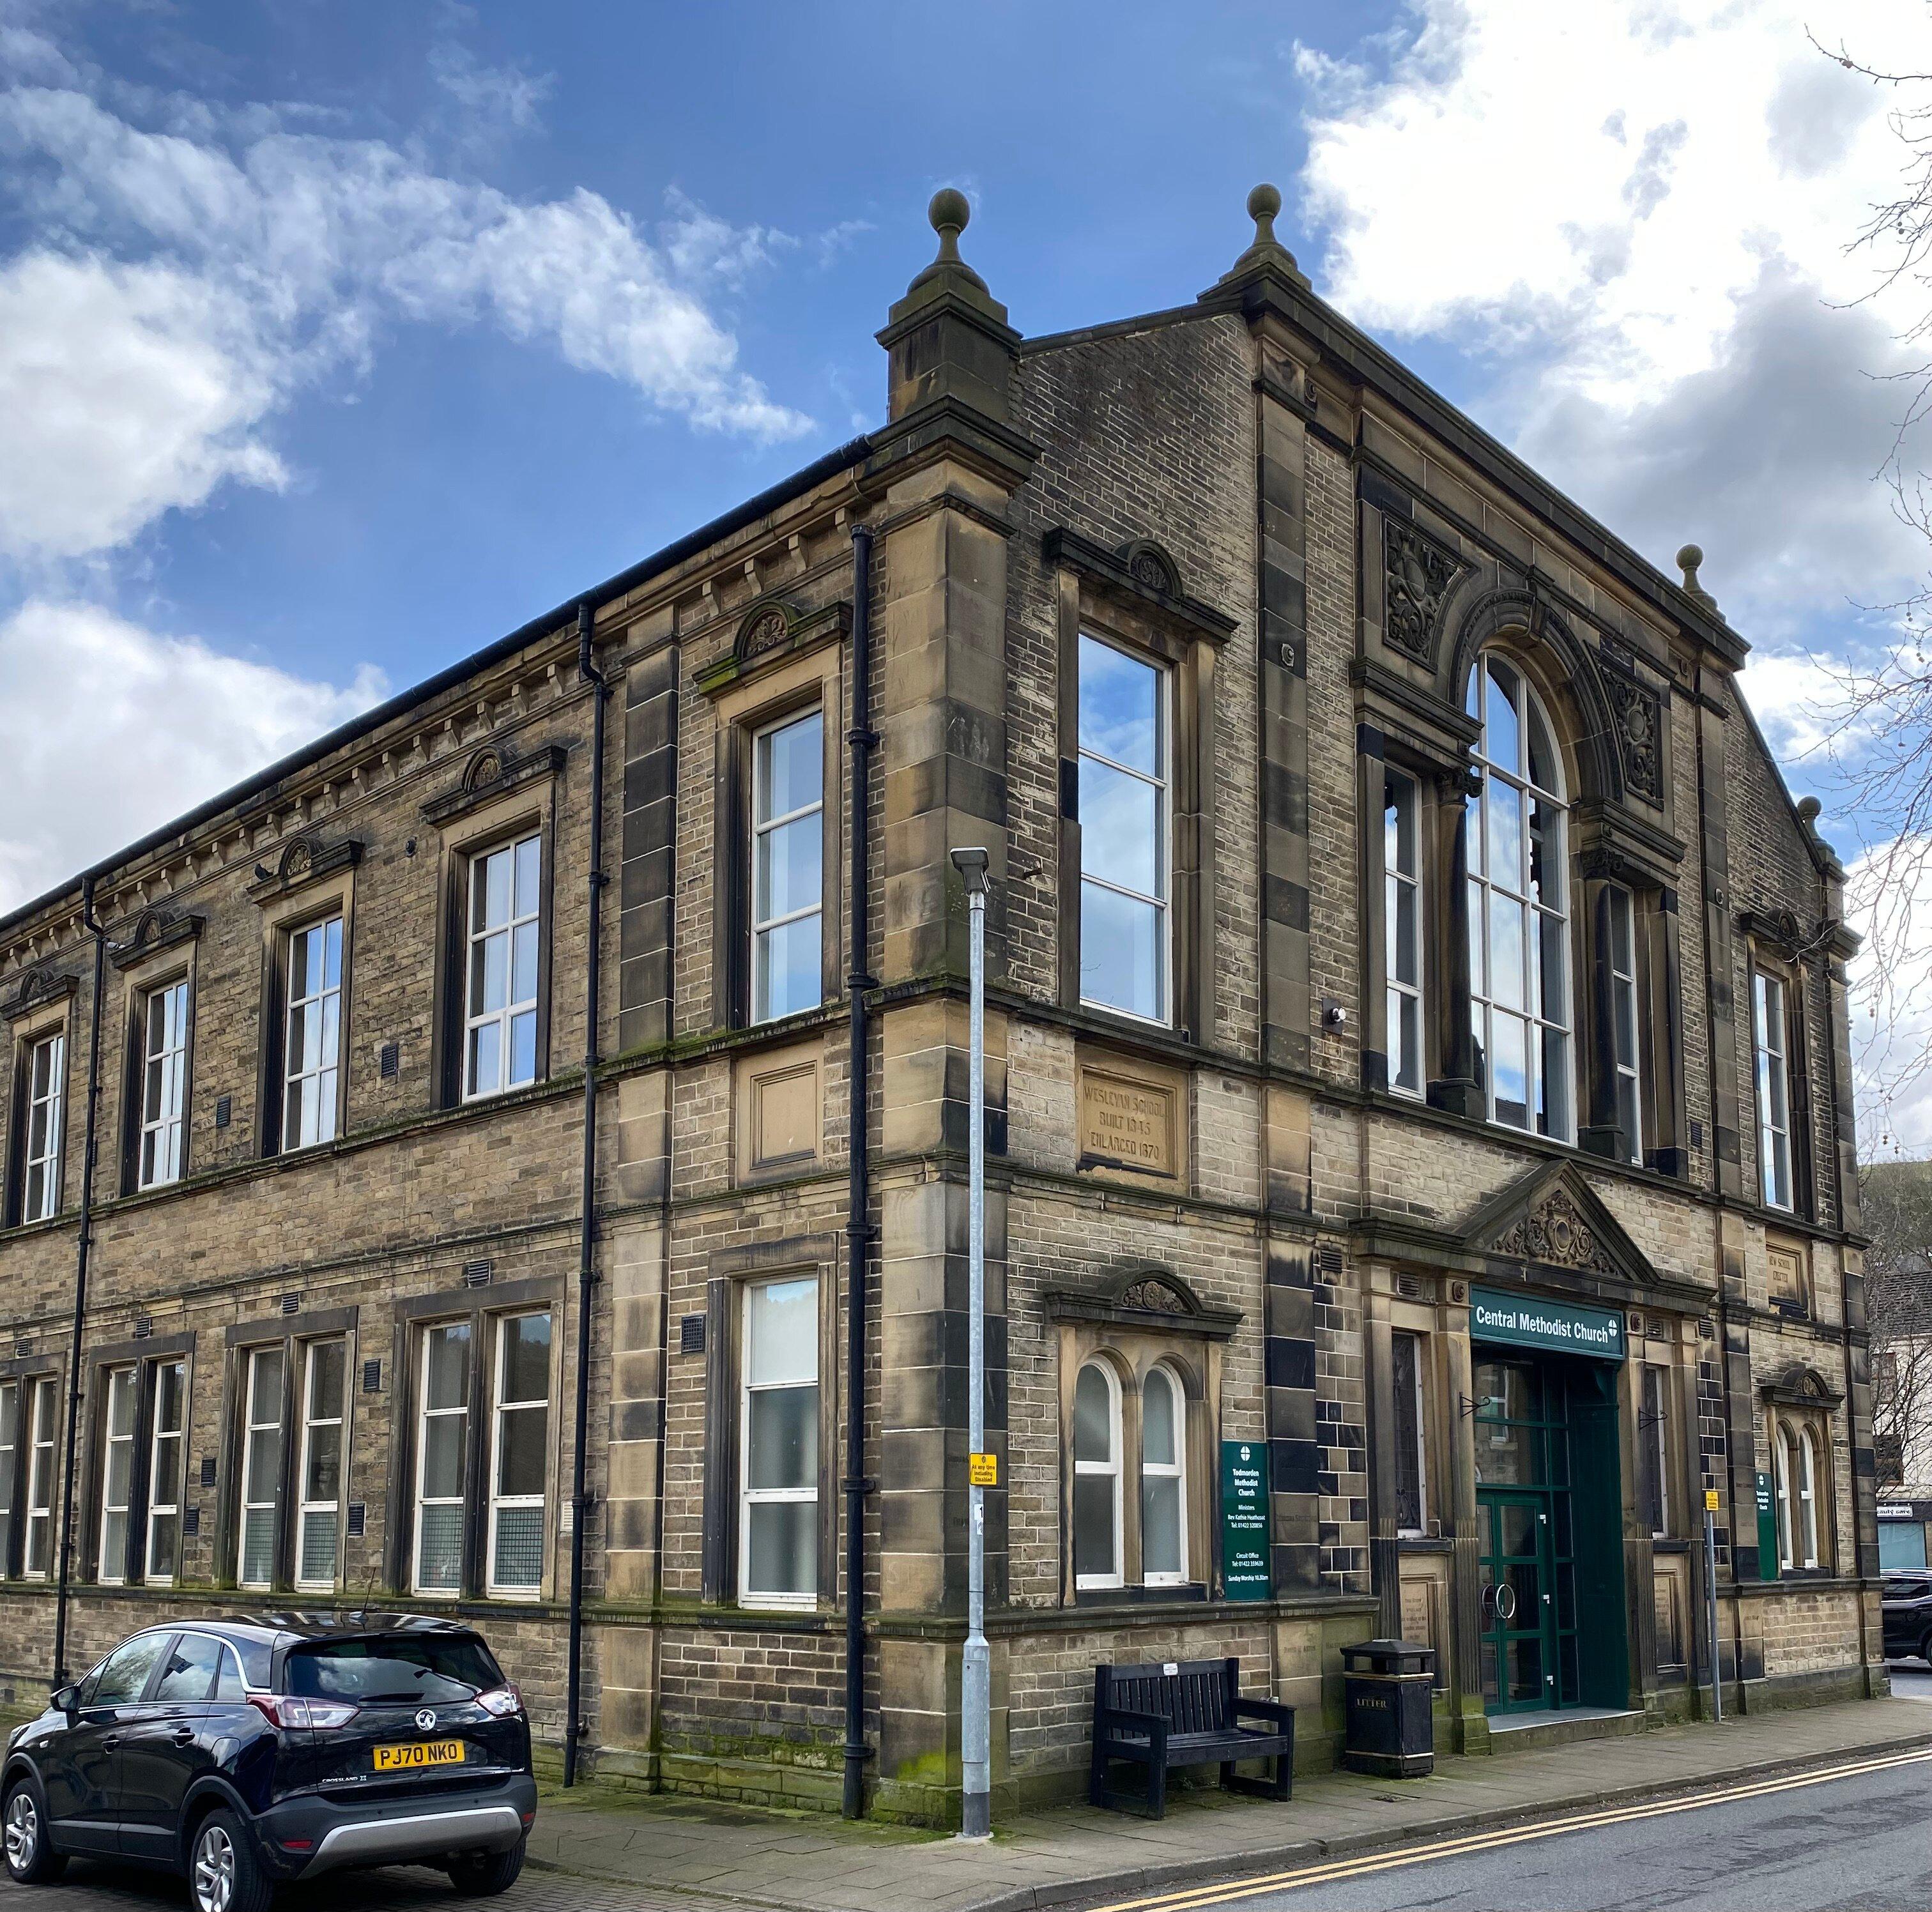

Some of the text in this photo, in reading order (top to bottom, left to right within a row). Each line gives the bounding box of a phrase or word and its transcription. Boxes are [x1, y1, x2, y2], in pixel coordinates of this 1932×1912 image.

[1132, 1097, 1165, 1118] SCHOOL
[1099, 1111, 1124, 1130] BUILT
[1090, 1131, 1159, 1160] ENLARGED 1870
[1476, 1306, 1608, 1343] Central Methodist Church
[1232, 1468, 1259, 1476] Todmorden
[1234, 1478, 1259, 1487] Methodist
[379, 1743, 457, 1766] PJ70 NKO
